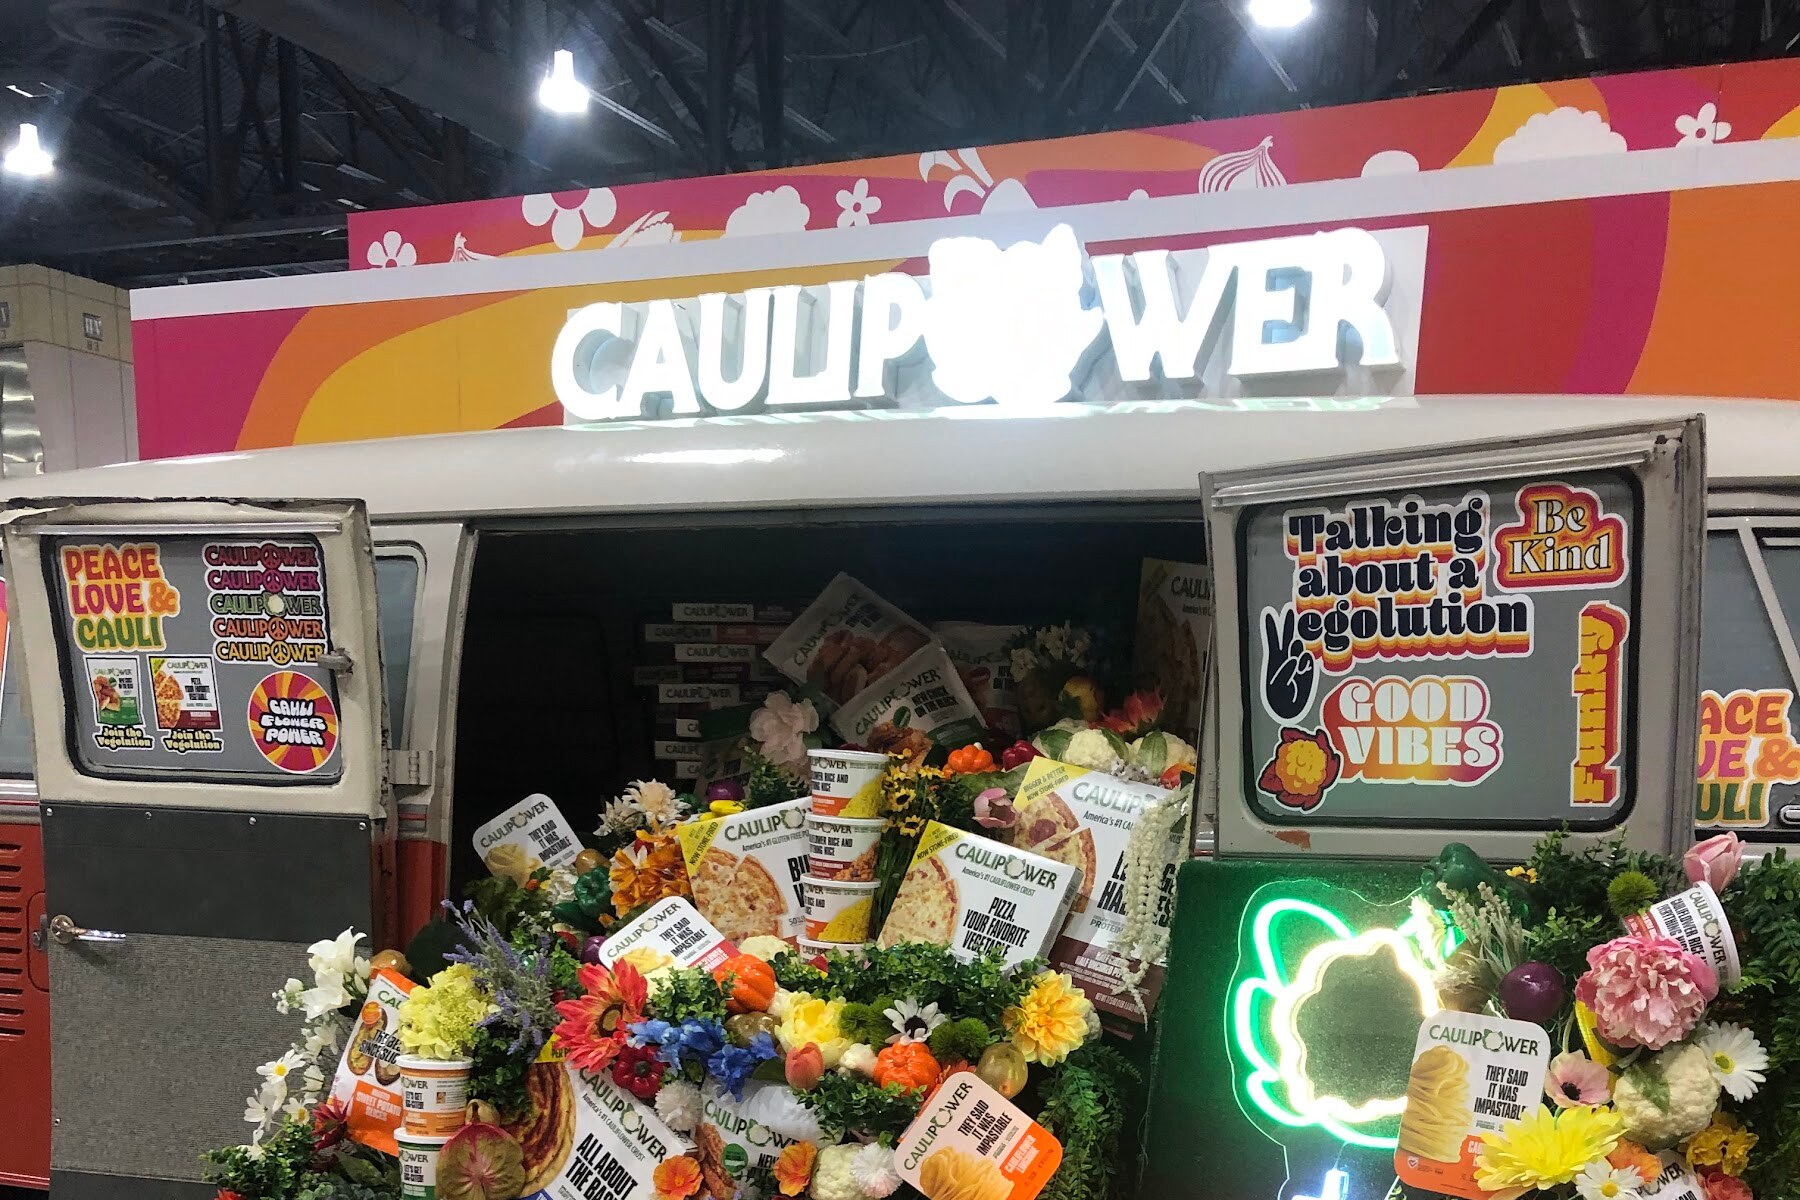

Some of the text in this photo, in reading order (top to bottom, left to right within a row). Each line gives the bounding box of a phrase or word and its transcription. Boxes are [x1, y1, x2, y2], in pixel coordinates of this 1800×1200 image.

[1288, 496, 1485, 554] Talking
[1535, 499, 1588, 536] Be
[64, 546, 161, 581] PEACE
[205, 543, 319, 570] CAULIPOWER
[1509, 533, 1613, 576] Kind
[208, 568, 322, 593] CAULIPOWER
[1297, 555, 1480, 597] about a
[71, 582, 180, 616] LOVE &
[210, 591, 324, 617] CAULIPOWER
[76, 617, 163, 648] CAULI
[213, 617, 326, 641] CAULIPOWER
[268, 699, 314, 717] CAULI
[855, 668, 942, 736] CAULIPOWER
[1340, 680, 1487, 723] GOOD
[1698, 696, 1786, 735] ACE
[103, 727, 142, 738] Join the
[171, 730, 211, 740] Join the
[260, 714, 327, 730] FLOWER
[265, 727, 325, 746] POWER
[96, 737, 152, 750] Vegolution
[165, 740, 221, 752] Vegolution
[1339, 723, 1499, 768] VIBES
[1756, 738, 1800, 778] &
[836, 773, 849, 784] AND
[1695, 783, 1764, 821] ULI
[480, 800, 550, 849] CAULIPOWER
[527, 820, 557, 843] THEY SAID
[1083, 810, 1123, 829] America's #1
[537, 831, 560, 850] IT WAS
[537, 836, 573, 863] IMPASTABLE
[742, 838, 766, 852] America's
[840, 838, 853, 848] AND
[689, 851, 701, 866] NOW
[955, 842, 1058, 890] CAULIPOWER
[961, 866, 985, 880] America's
[988, 896, 1018, 923] PIZZA.
[606, 902, 682, 959] CAULIPOWER
[658, 916, 691, 942] THEY SAID
[670, 928, 695, 946] IT WAS
[962, 908, 1031, 948] YOUR FAVORITE
[1670, 897, 1705, 956] CAULIFLOWER RICE
[1688, 891, 1727, 966] CAULIPOWER
[670, 929, 708, 958] IMPASTABLE
[1429, 1024, 1540, 1057] CAULIPOWER
[1485, 1064, 1530, 1088] THEY SAID
[1487, 1082, 1520, 1103] IT WAS
[903, 1081, 974, 1172] CAULIPOWER
[957, 1099, 990, 1138] THEY SAID
[971, 1113, 997, 1141] IT WAS
[604, 1117, 638, 1154] CAULIFLOWER
[975, 1111, 1013, 1156] IMPASTABLE
[575, 1132, 603, 1166] ALL
[564, 1156, 592, 1191] THE
